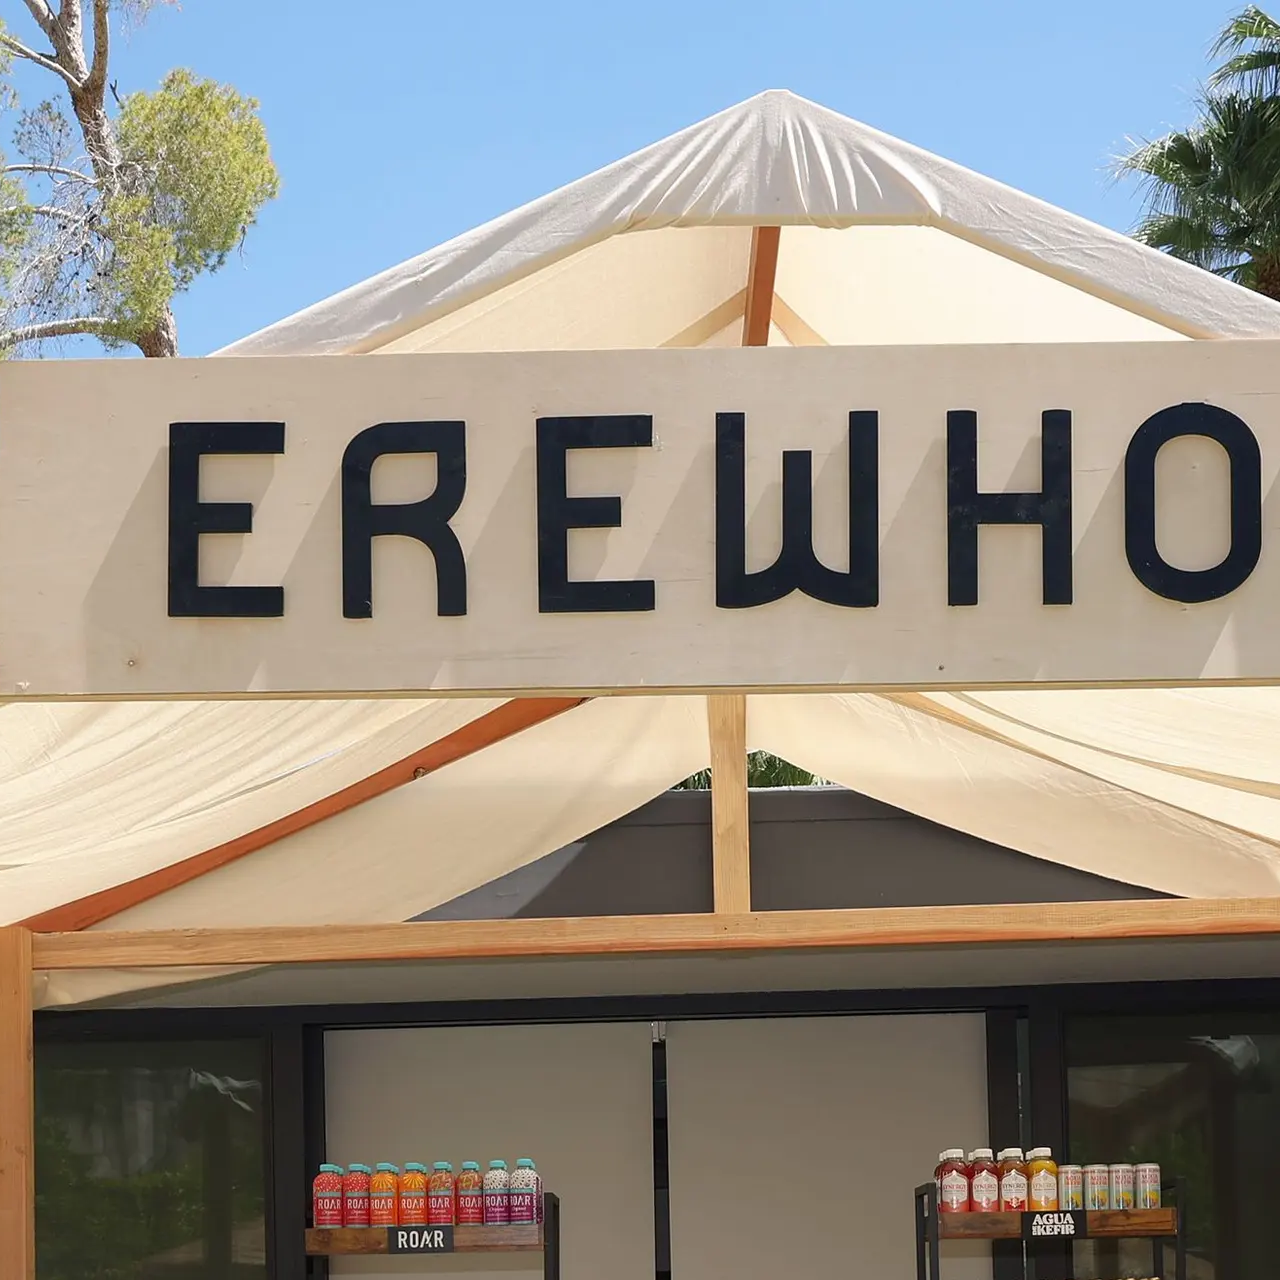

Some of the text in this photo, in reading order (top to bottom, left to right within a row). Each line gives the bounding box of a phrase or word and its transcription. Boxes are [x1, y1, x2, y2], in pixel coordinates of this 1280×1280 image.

[1032, 1213, 1074, 1225] AGUA
[1037, 1225, 1075, 1235] KEFIR
[398, 1230, 444, 1248] ROAR
